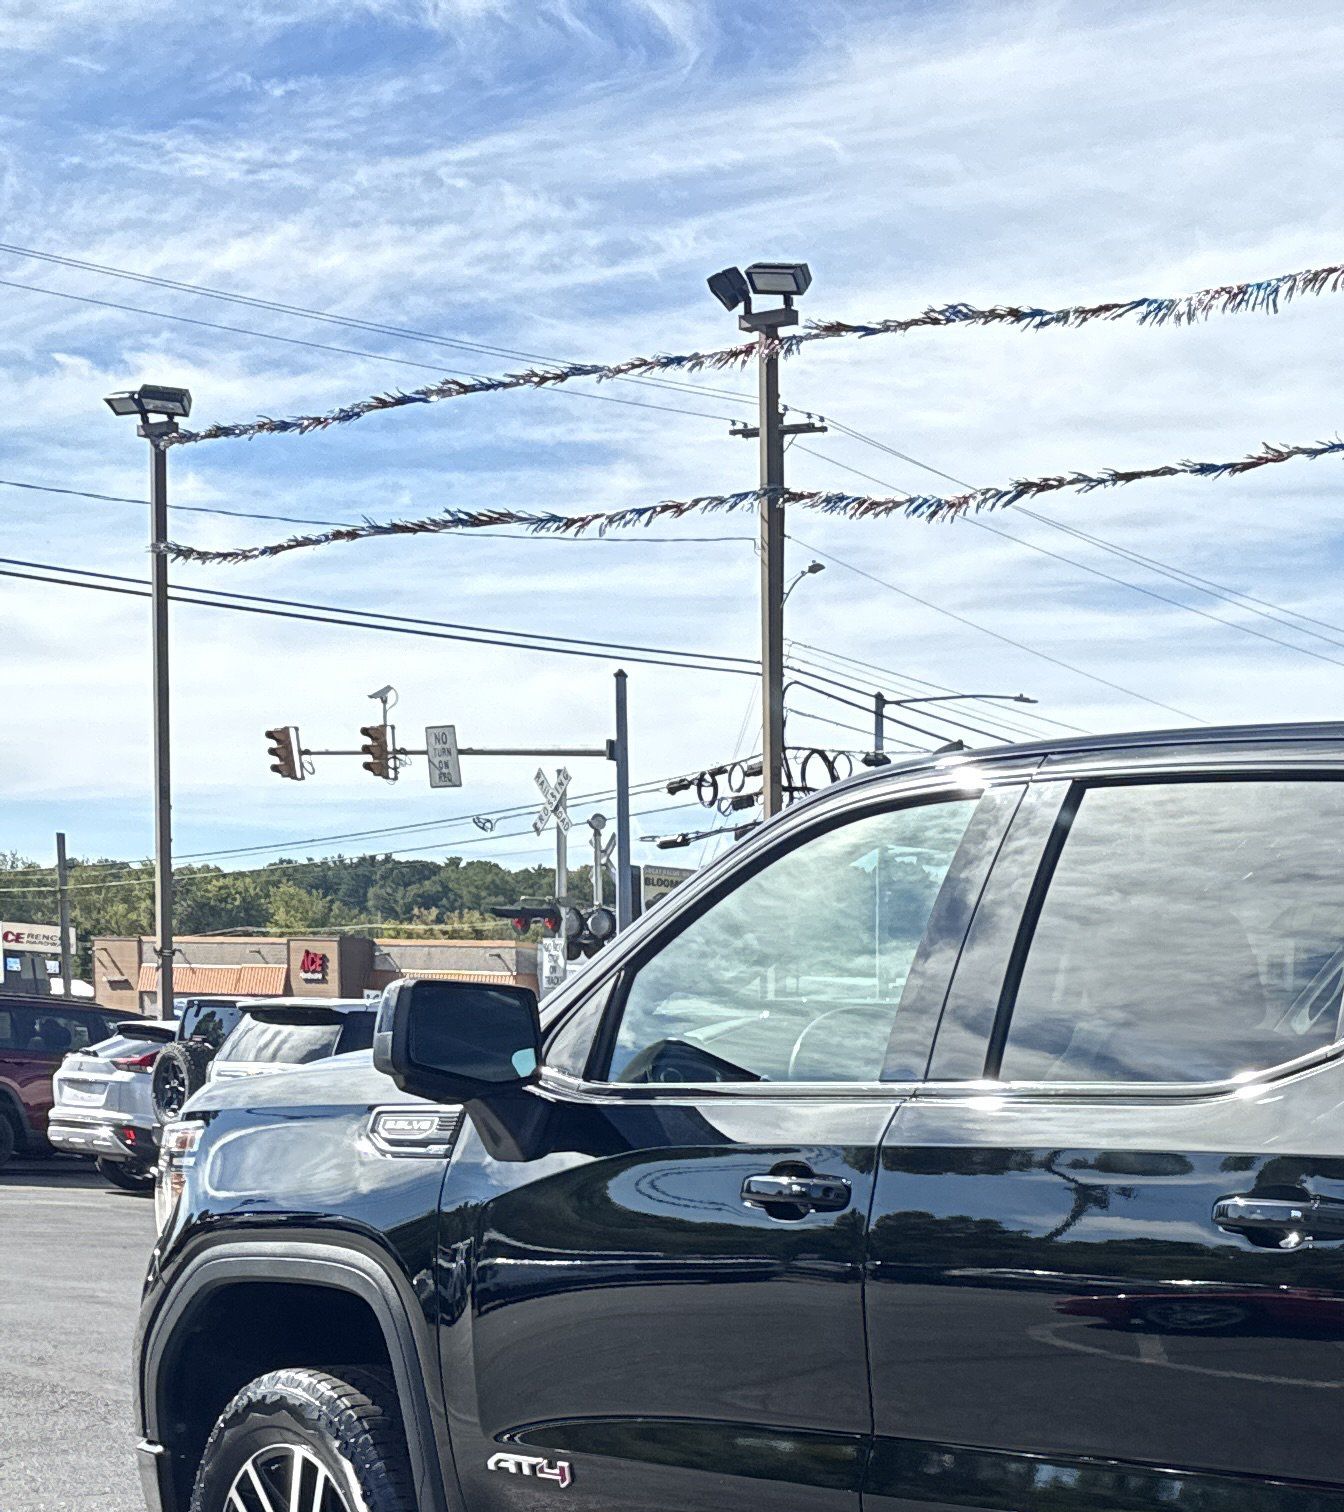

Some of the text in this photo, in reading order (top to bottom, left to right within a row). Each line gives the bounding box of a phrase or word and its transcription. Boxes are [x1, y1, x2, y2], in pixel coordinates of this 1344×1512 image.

[434, 731, 448, 745] NO
[438, 760, 449, 770] ON
[3, 931, 61, 944] CE RENC
[300, 949, 324, 972] ACE
[487, 1452, 571, 1488] AT4
